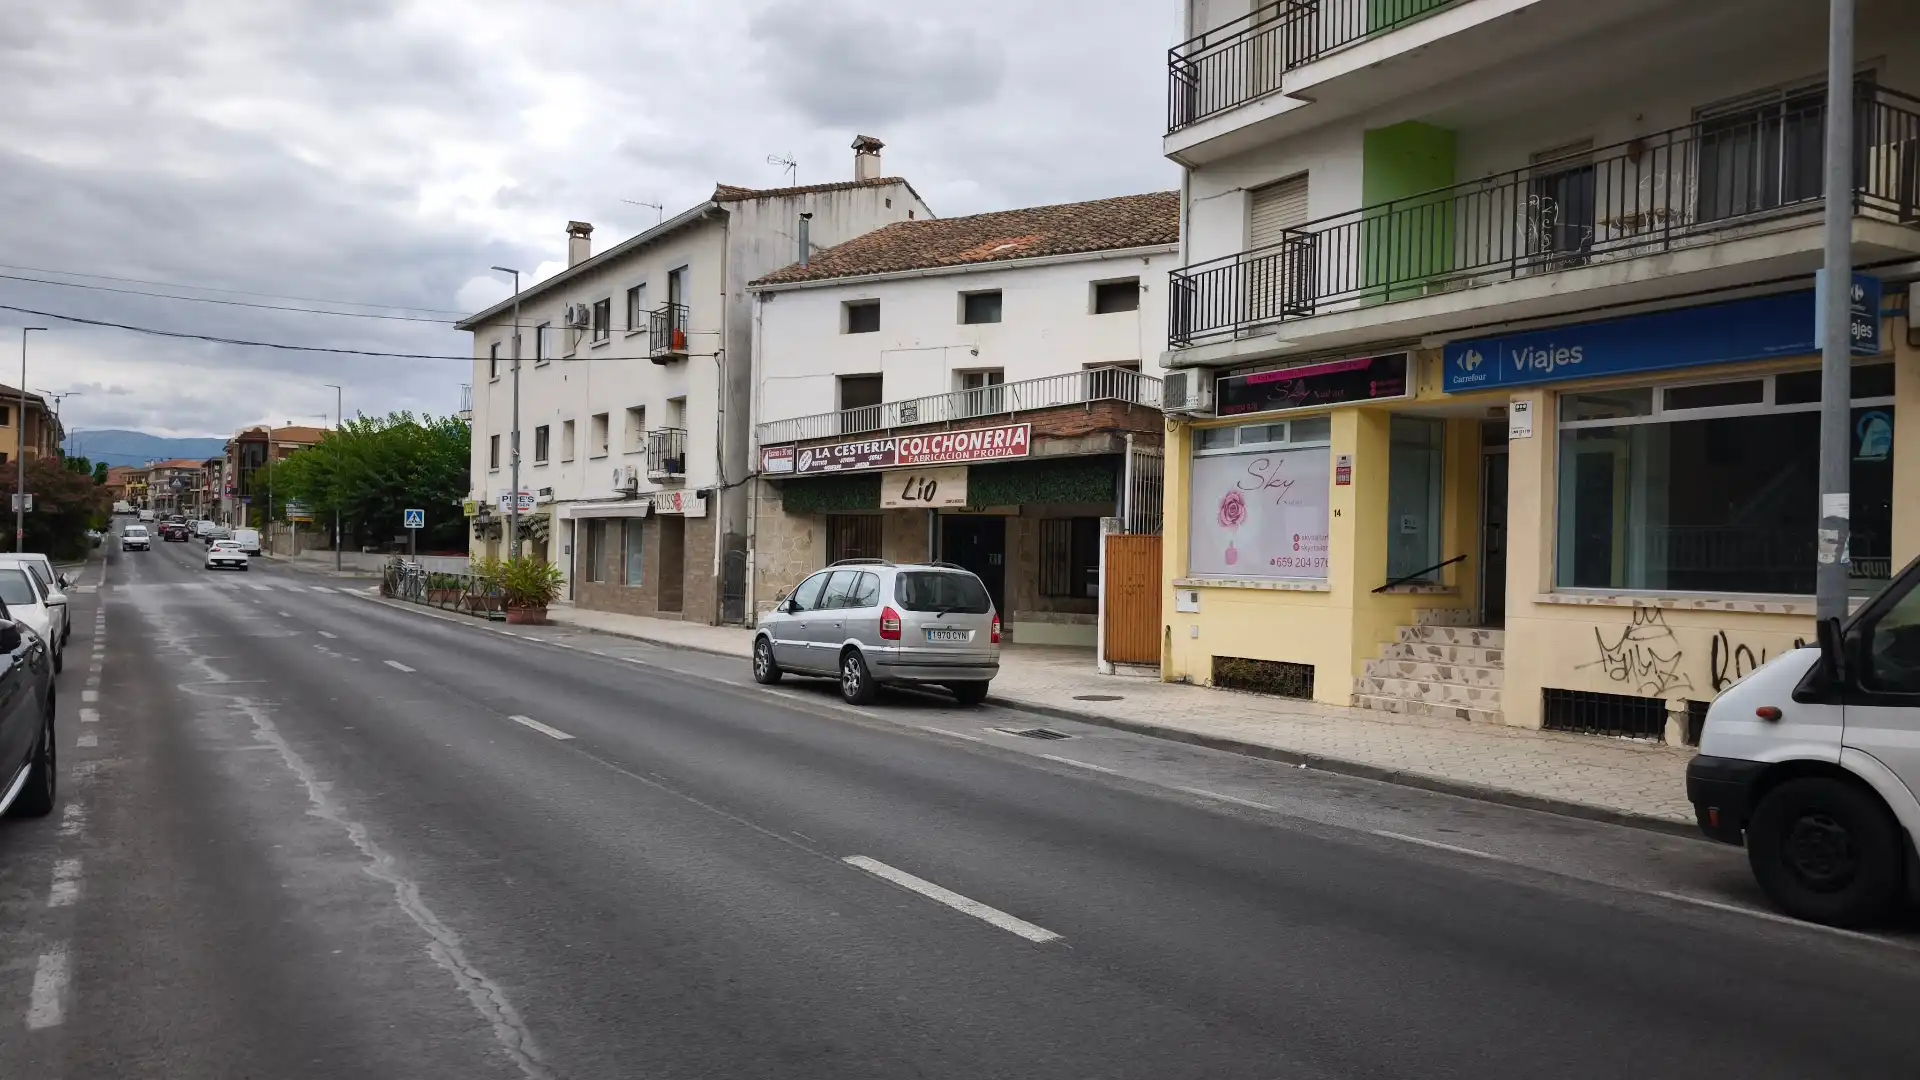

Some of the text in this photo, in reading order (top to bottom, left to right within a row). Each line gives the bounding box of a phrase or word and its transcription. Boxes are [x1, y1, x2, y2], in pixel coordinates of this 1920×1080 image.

[1850, 320, 1873, 340] ajes
[1512, 343, 1583, 373] Viajes
[1453, 373, 1487, 384] Carrefour
[1267, 379, 1313, 407] Sky
[815, 440, 895, 459] LA CESTERIA
[900, 427, 1025, 456] COLCHONERIA
[908, 447, 1014, 463] FABRICACION PROPIA
[1236, 458, 1296, 505] Sky
[502, 495, 535, 503] PIE'S
[656, 493, 675, 510] KUSS
[1333, 508, 1341, 518] 14
[1276, 557, 1293, 568] 659
[1295, 557, 1311, 568] 204
[952, 631, 966, 639] CYN
